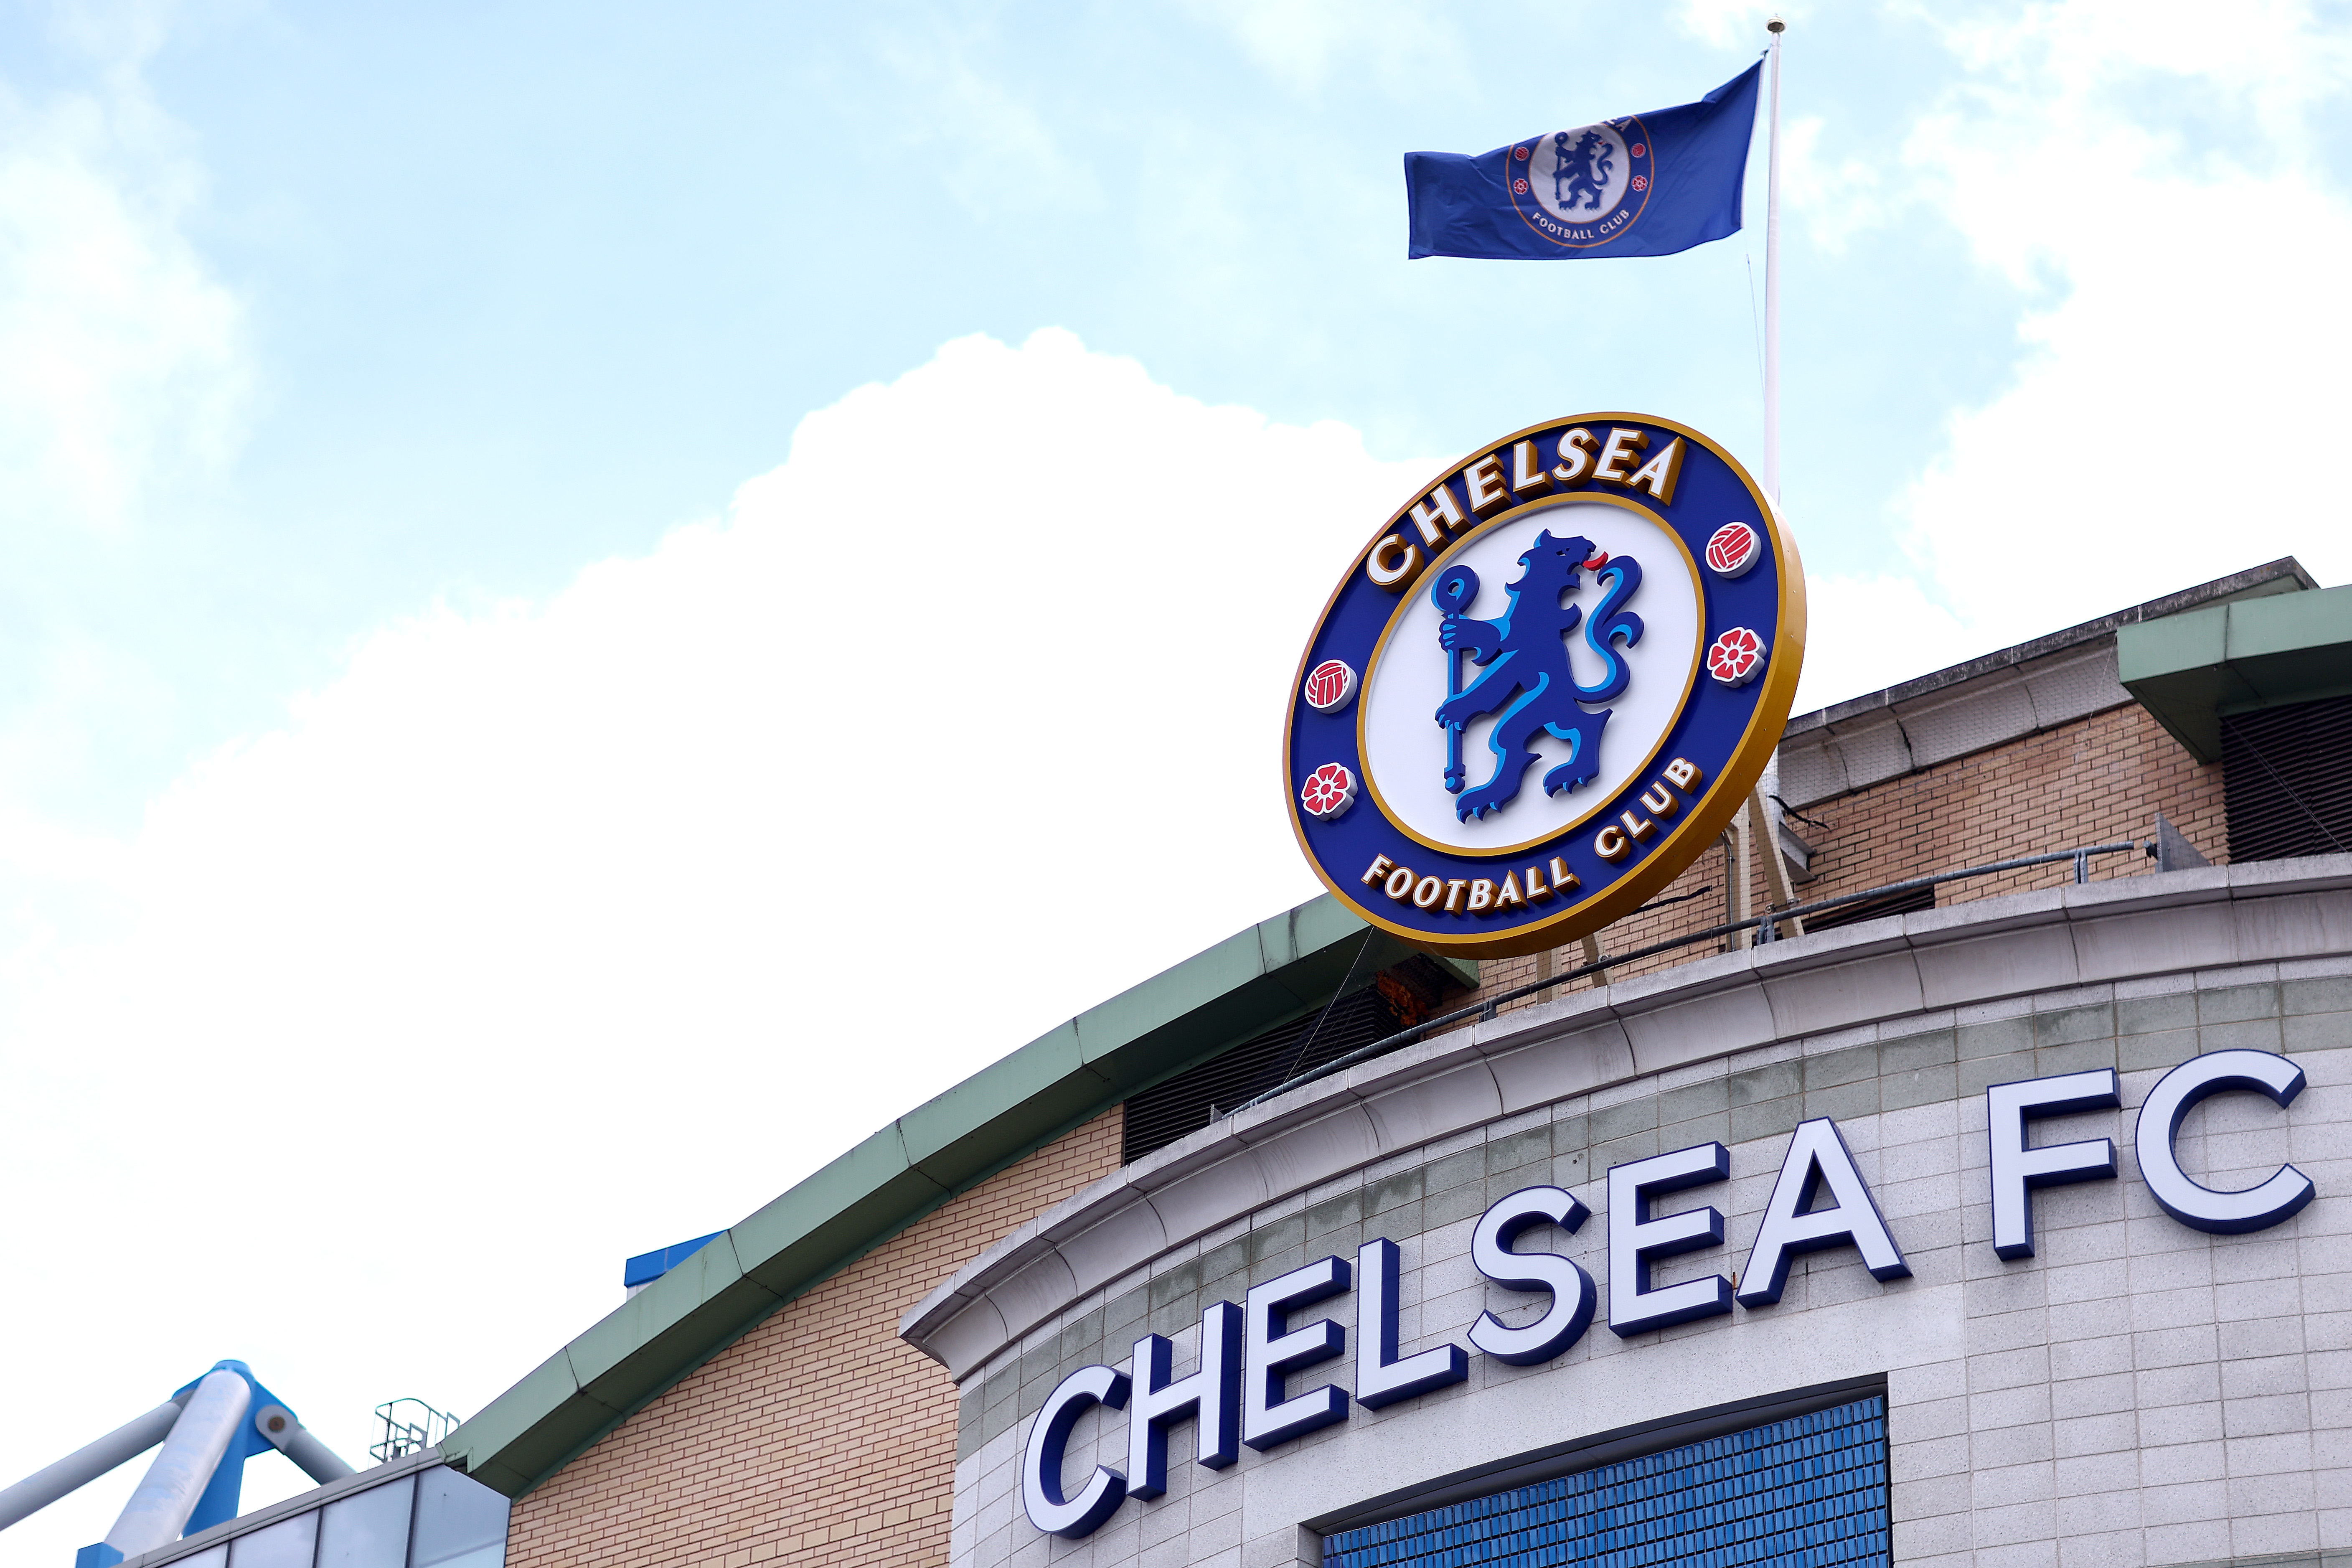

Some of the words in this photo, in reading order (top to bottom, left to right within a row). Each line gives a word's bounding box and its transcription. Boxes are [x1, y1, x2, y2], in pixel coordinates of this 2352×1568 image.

[1532, 211, 1595, 240] FOOTBALL
[1599, 209, 1630, 234] CLUB
[1367, 427, 1687, 592] CHELSEA
[1361, 853, 1580, 915] FOOTBALL
[1594, 757, 1703, 863] CLUB
[1021, 1116, 1913, 1539] CHELSEA
[1986, 1048, 2318, 1261] FC
